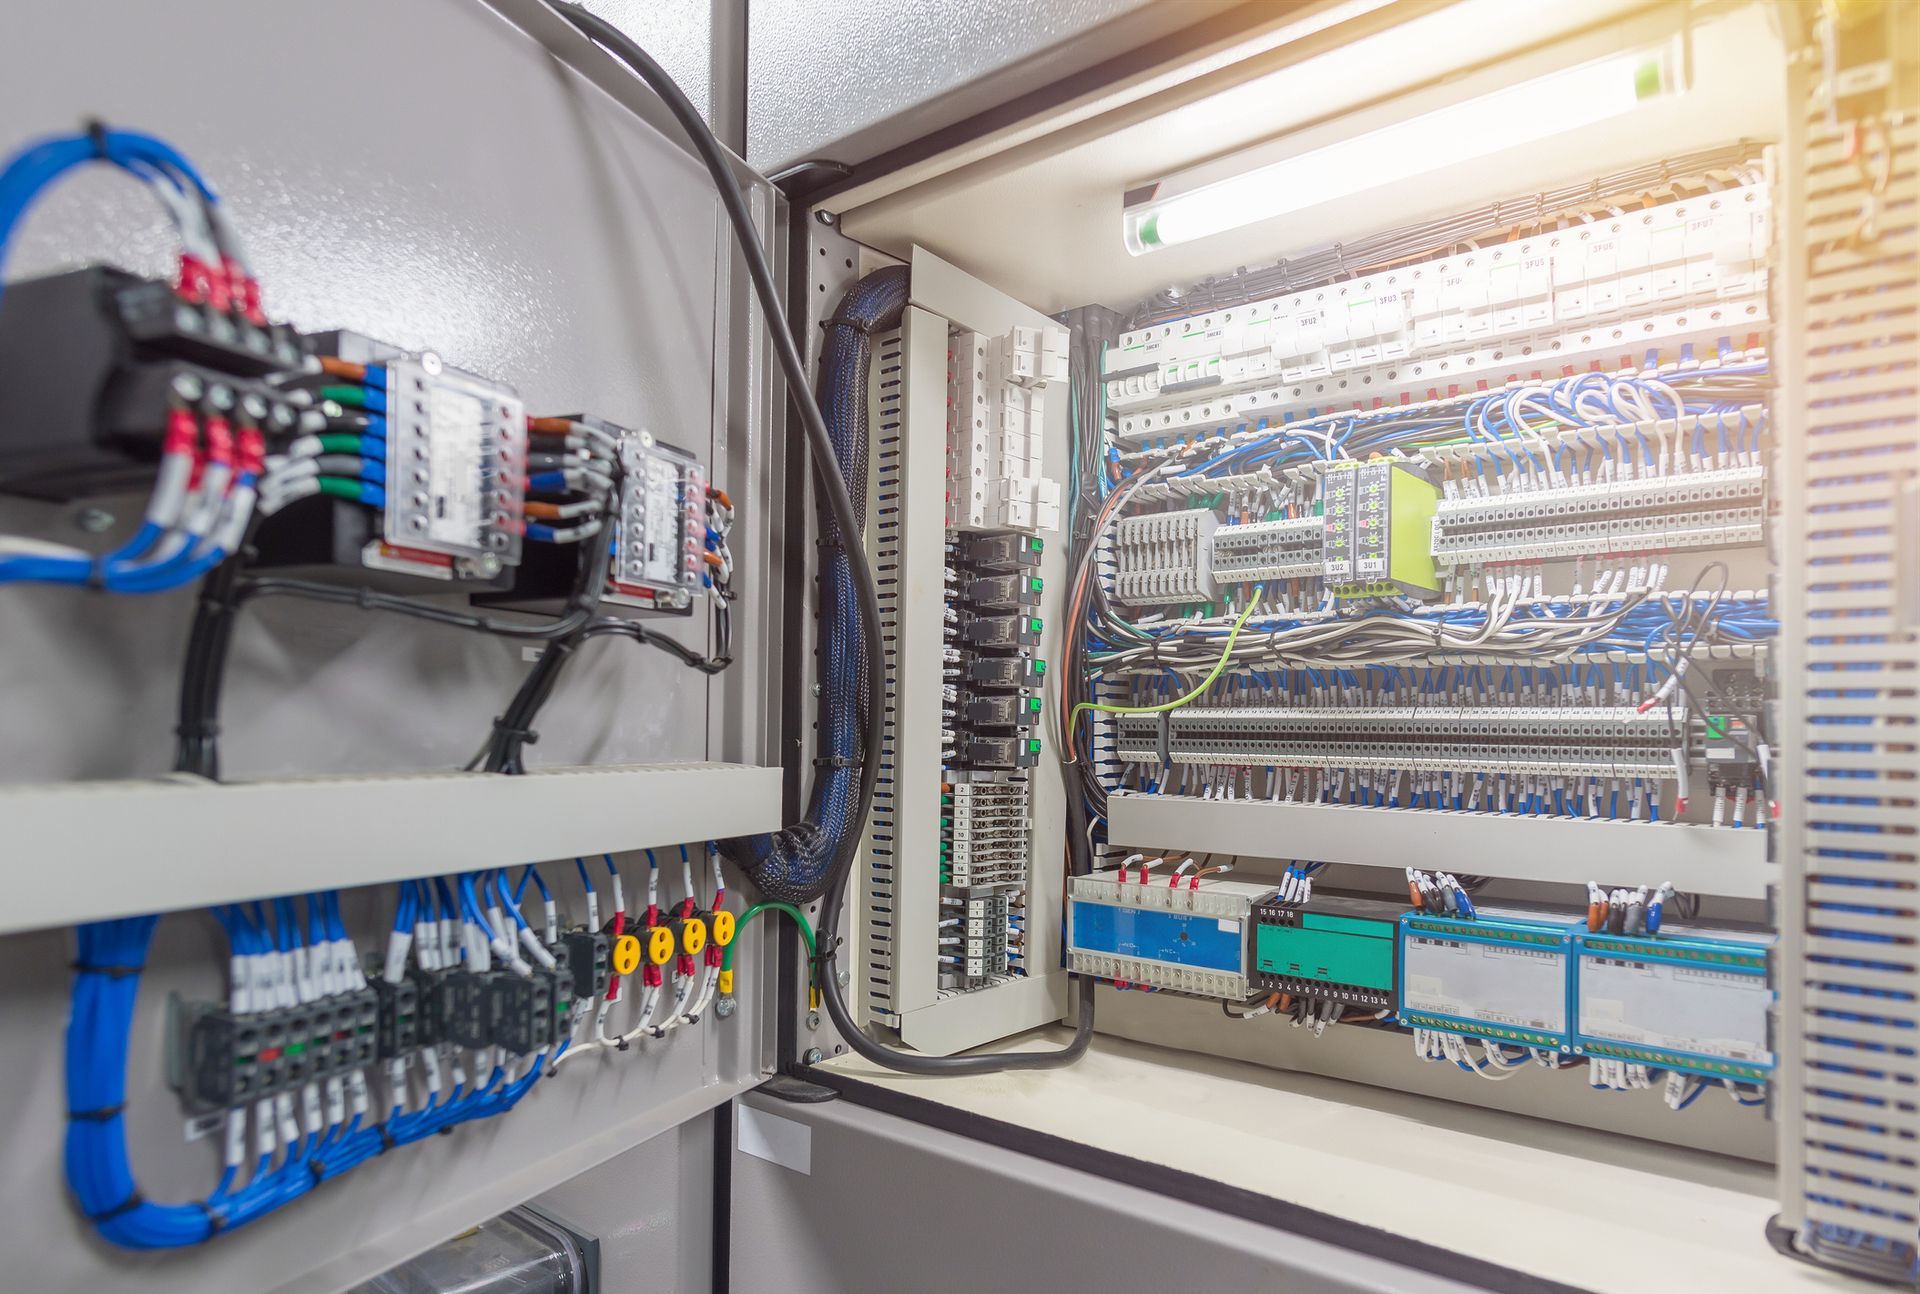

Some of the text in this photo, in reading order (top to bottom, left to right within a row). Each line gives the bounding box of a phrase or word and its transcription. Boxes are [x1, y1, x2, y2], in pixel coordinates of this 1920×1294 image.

[1524, 257, 1545, 270] 3FU5
[1379, 294, 1397, 305] 3FU3
[1300, 317, 1317, 327] 3FU2
[1331, 563, 1345, 572] 3U2
[1363, 561, 1377, 569] 3U1
[1277, 909, 1285, 917] 17
[1286, 910, 1294, 918] 18
[1269, 981, 1274, 989] 2
[1278, 982, 1283, 990] 3
[1304, 986, 1310, 994] 6
[1323, 989, 1329, 997] 8
[1341, 992, 1349, 1000] 10
[1352, 993, 1358, 1001] 11
[1360, 995, 1369, 1003] 12
[1370, 996, 1379, 1004] 13
